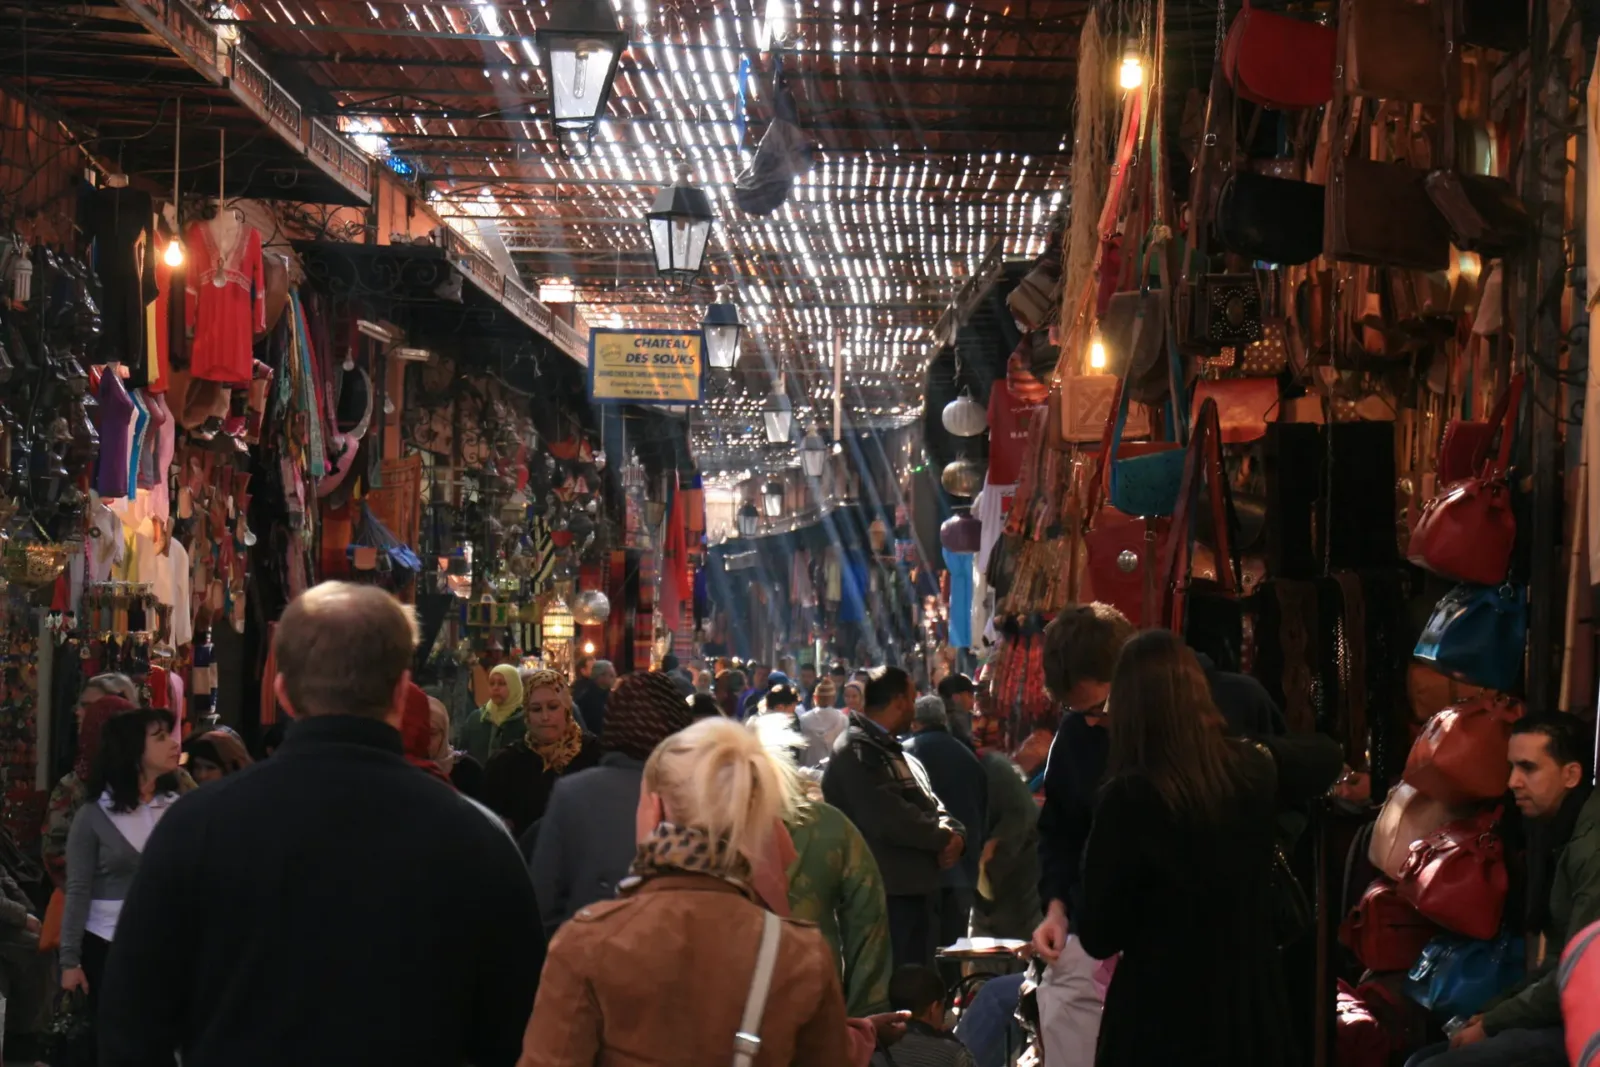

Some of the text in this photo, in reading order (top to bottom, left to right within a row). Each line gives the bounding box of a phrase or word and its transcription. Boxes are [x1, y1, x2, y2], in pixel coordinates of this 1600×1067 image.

[634, 338, 692, 349] CHATEAU
[626, 353, 695, 365] DES SOUKS
